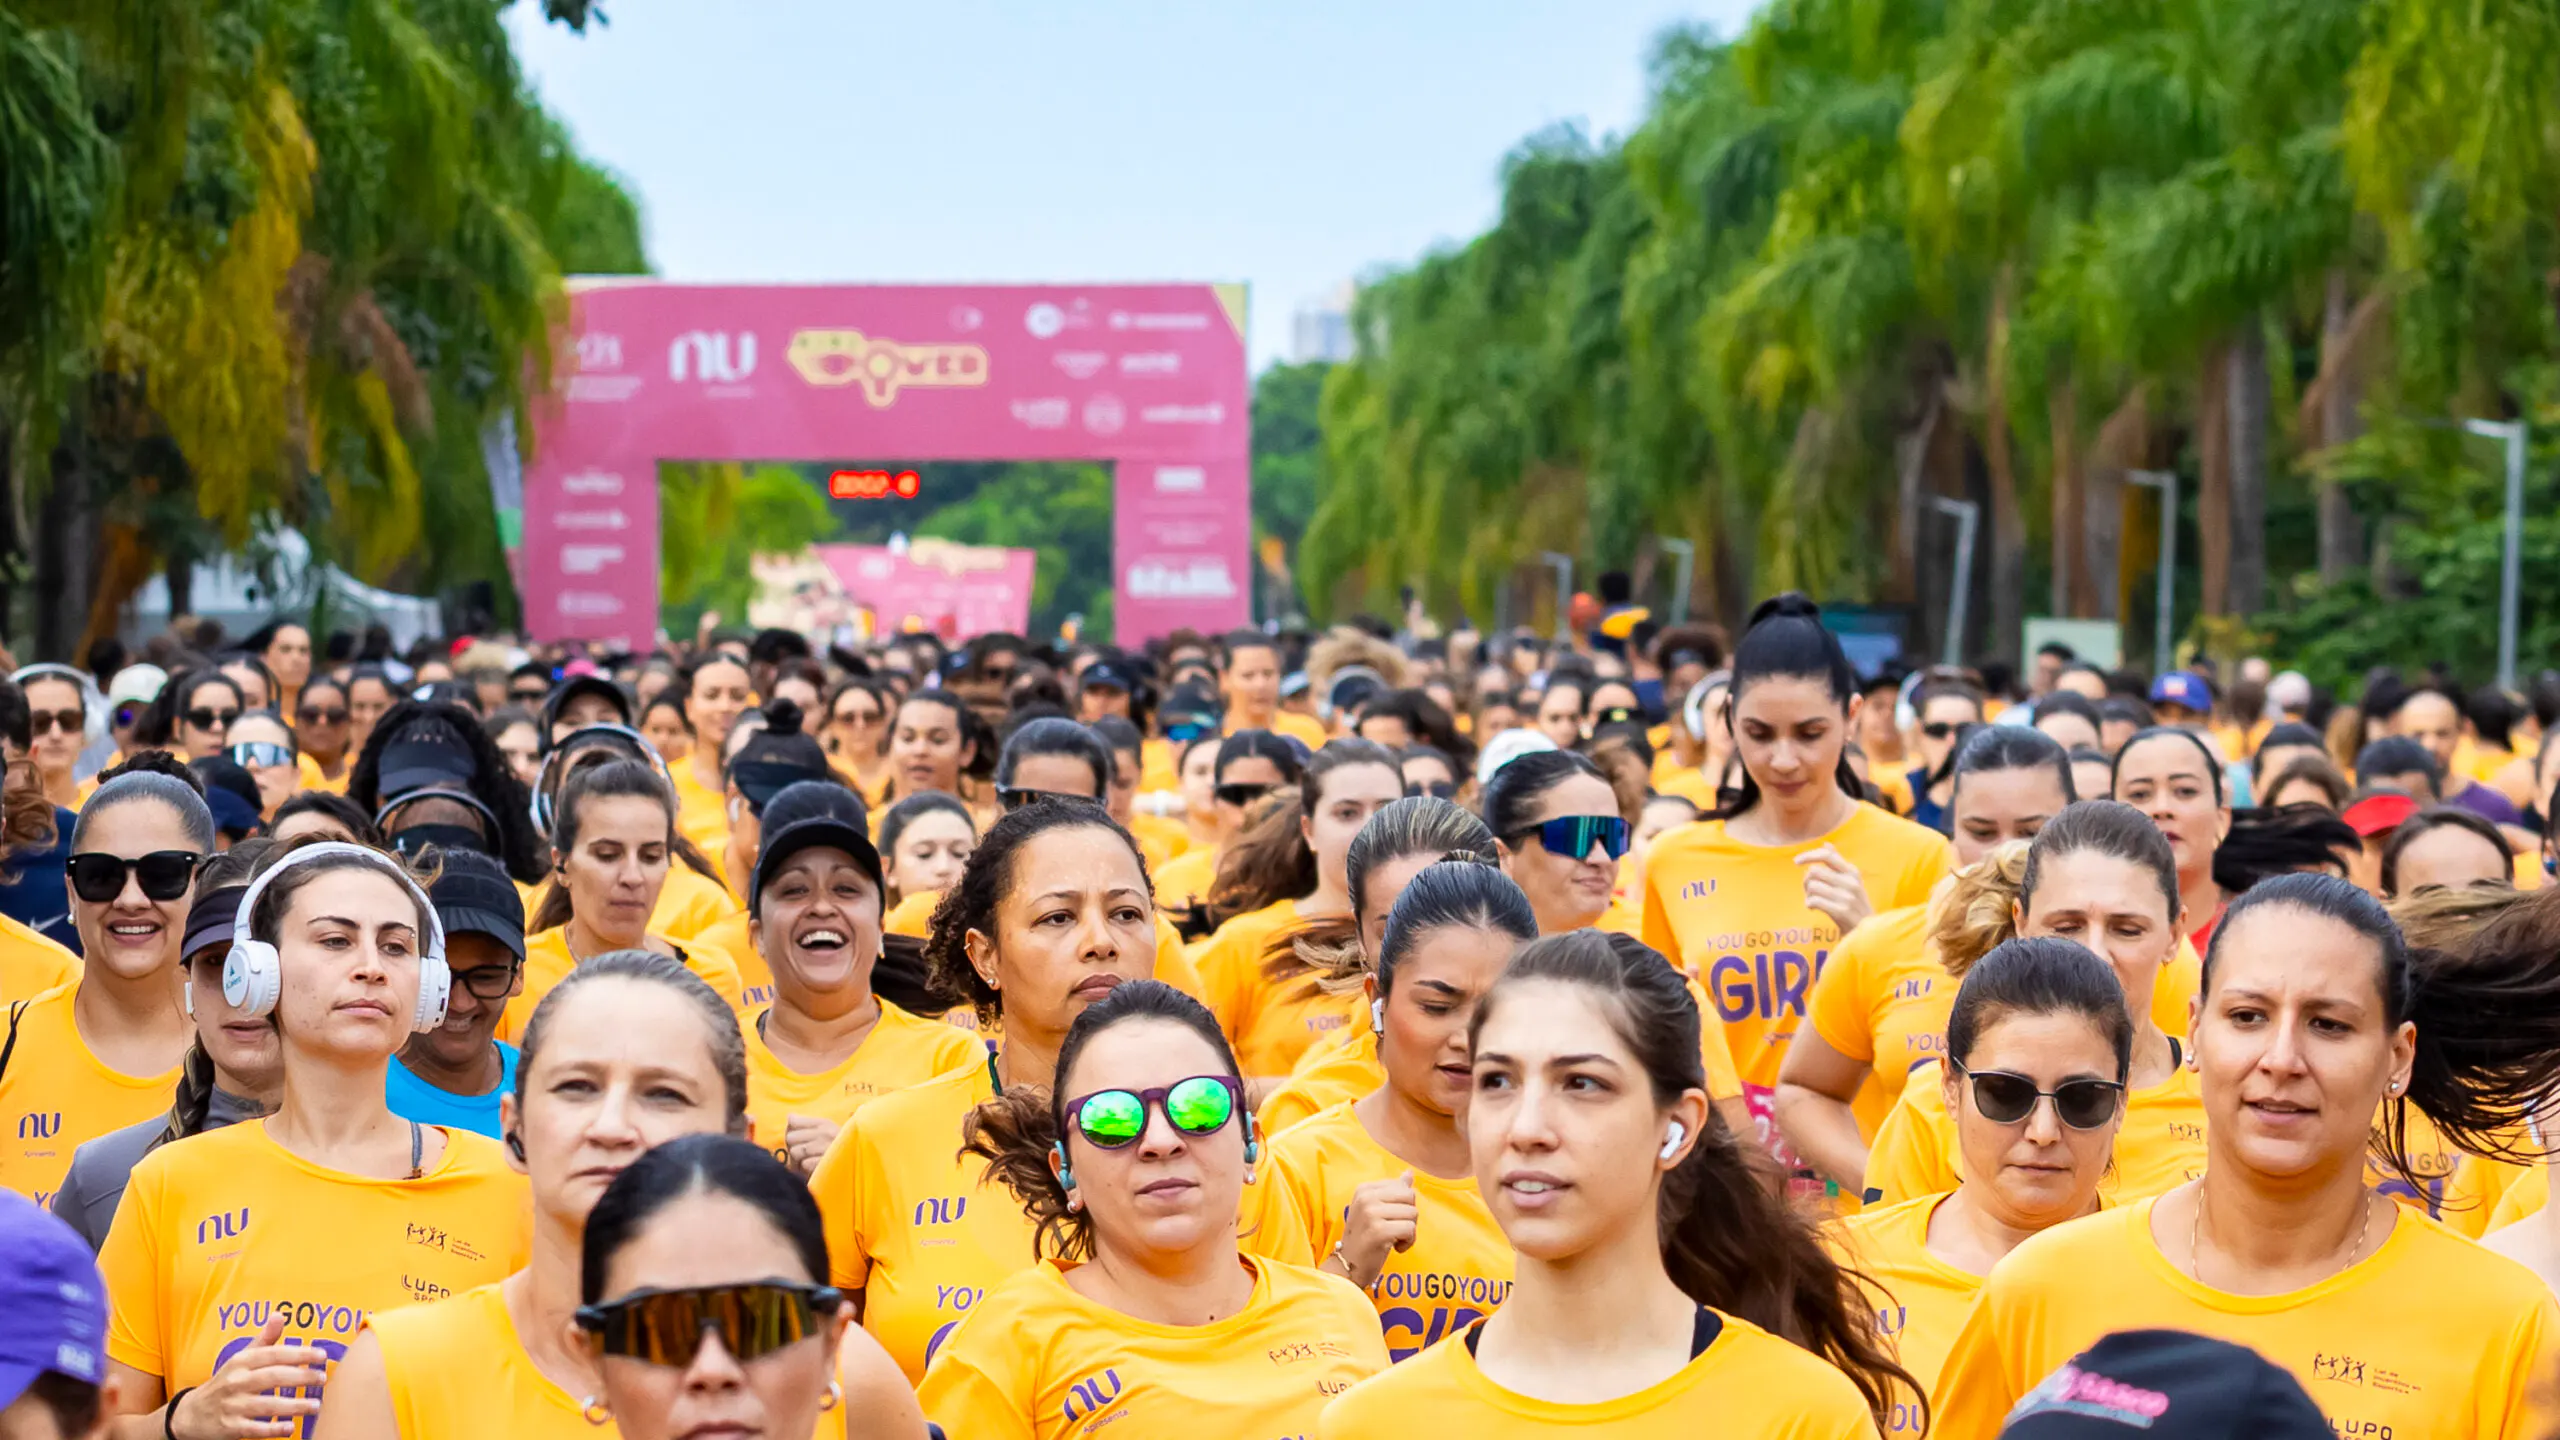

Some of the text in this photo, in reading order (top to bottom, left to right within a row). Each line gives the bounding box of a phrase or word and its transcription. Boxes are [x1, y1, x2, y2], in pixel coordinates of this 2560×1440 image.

[1707, 927, 1841, 951] YOUGOYOURU
[401, 1274, 450, 1299] LUPO
[1315, 1379, 1352, 1397] LUP
[2329, 1417, 2393, 1440] LUPO
